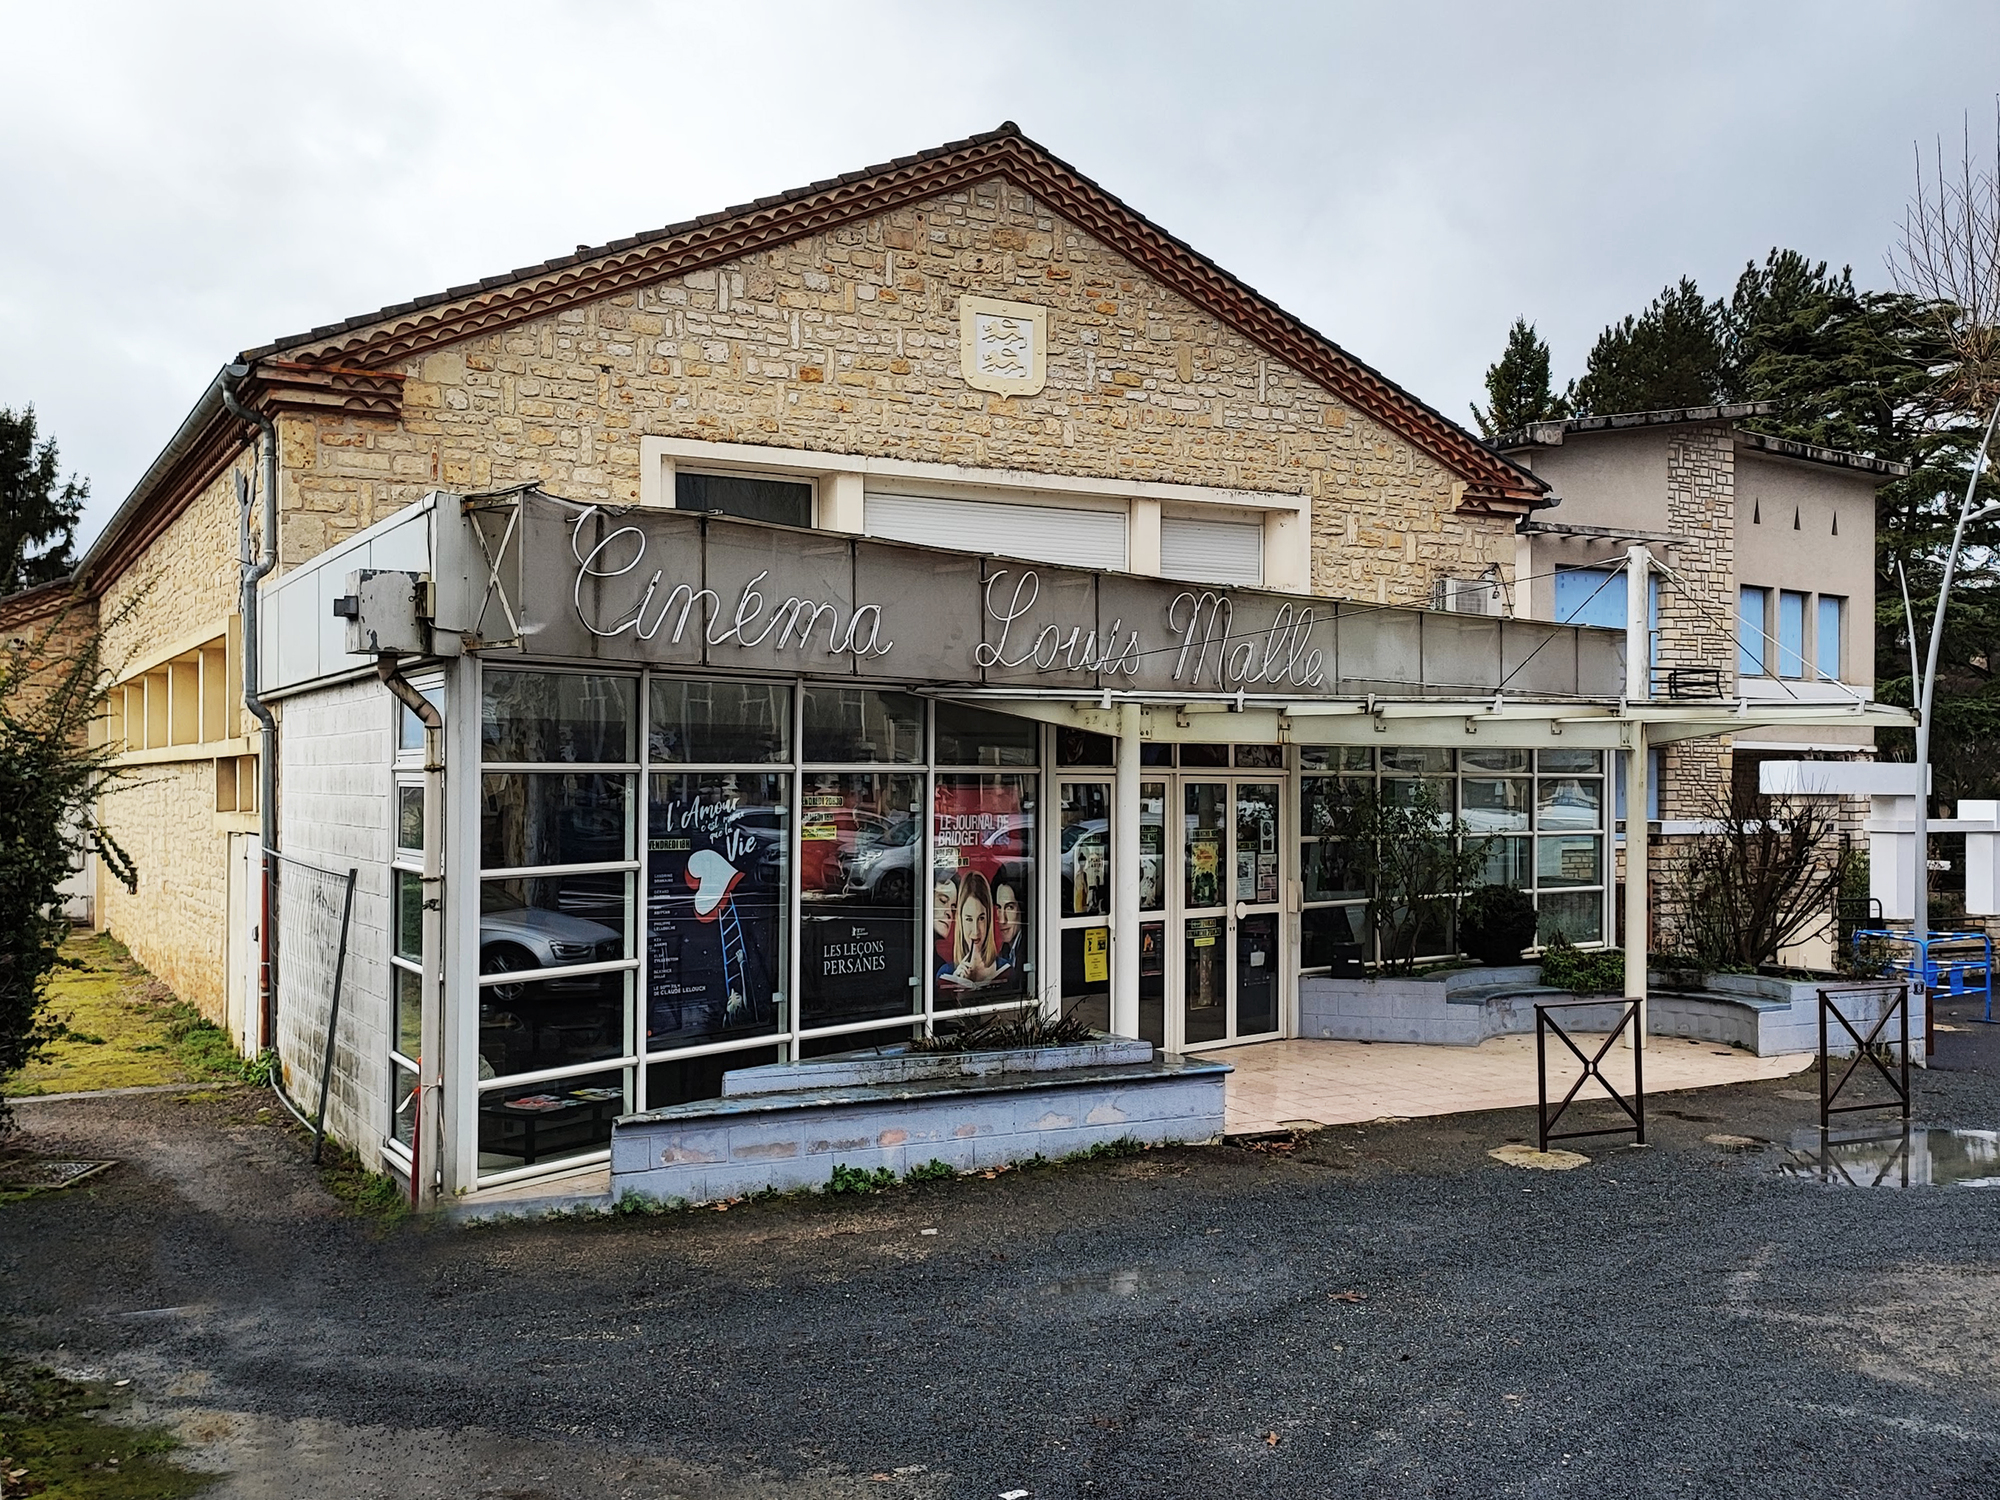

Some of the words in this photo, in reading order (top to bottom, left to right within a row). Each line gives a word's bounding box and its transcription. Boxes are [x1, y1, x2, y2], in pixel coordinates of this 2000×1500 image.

[567, 504, 894, 661] Cinéma
[975, 569, 1142, 676] Louis
[1168, 590, 1325, 690] Malle
[666, 795, 740, 832] l'Amour
[940, 814, 951, 831] LE
[952, 814, 995, 830] JOURNAL
[725, 828, 757, 862] Vie
[938, 830, 979, 847] BRIDGET
[823, 943, 842, 958] LES
[843, 940, 884, 958] LEÇONS
[823, 955, 886, 976] PERSANES
